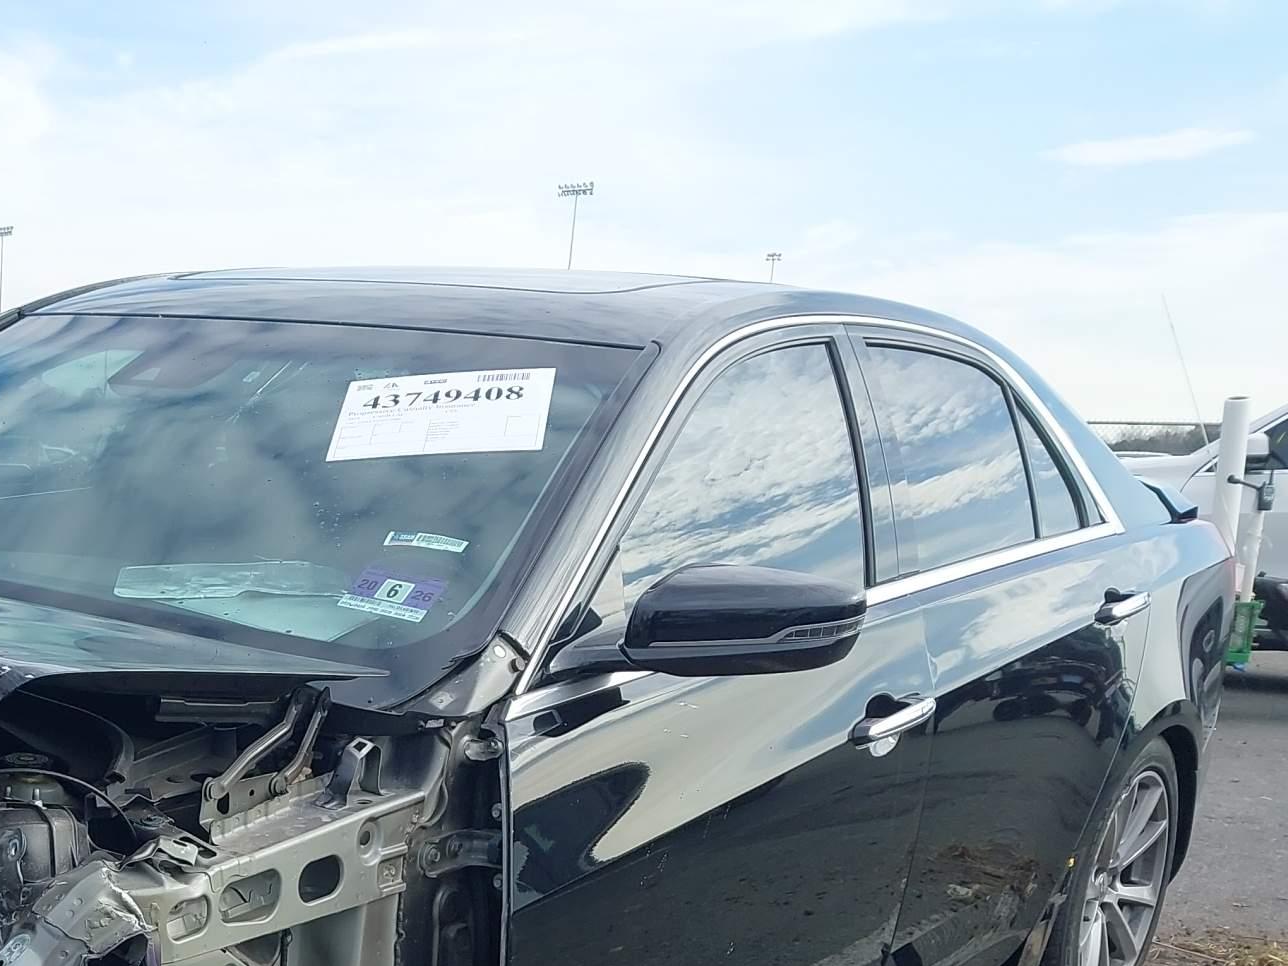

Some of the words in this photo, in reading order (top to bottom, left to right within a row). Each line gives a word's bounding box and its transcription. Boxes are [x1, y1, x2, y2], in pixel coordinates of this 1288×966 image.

[362, 386, 524, 409] 43749408
[357, 579, 379, 591] 20
[386, 583, 403, 599] 6
[411, 590, 434, 602] 26
